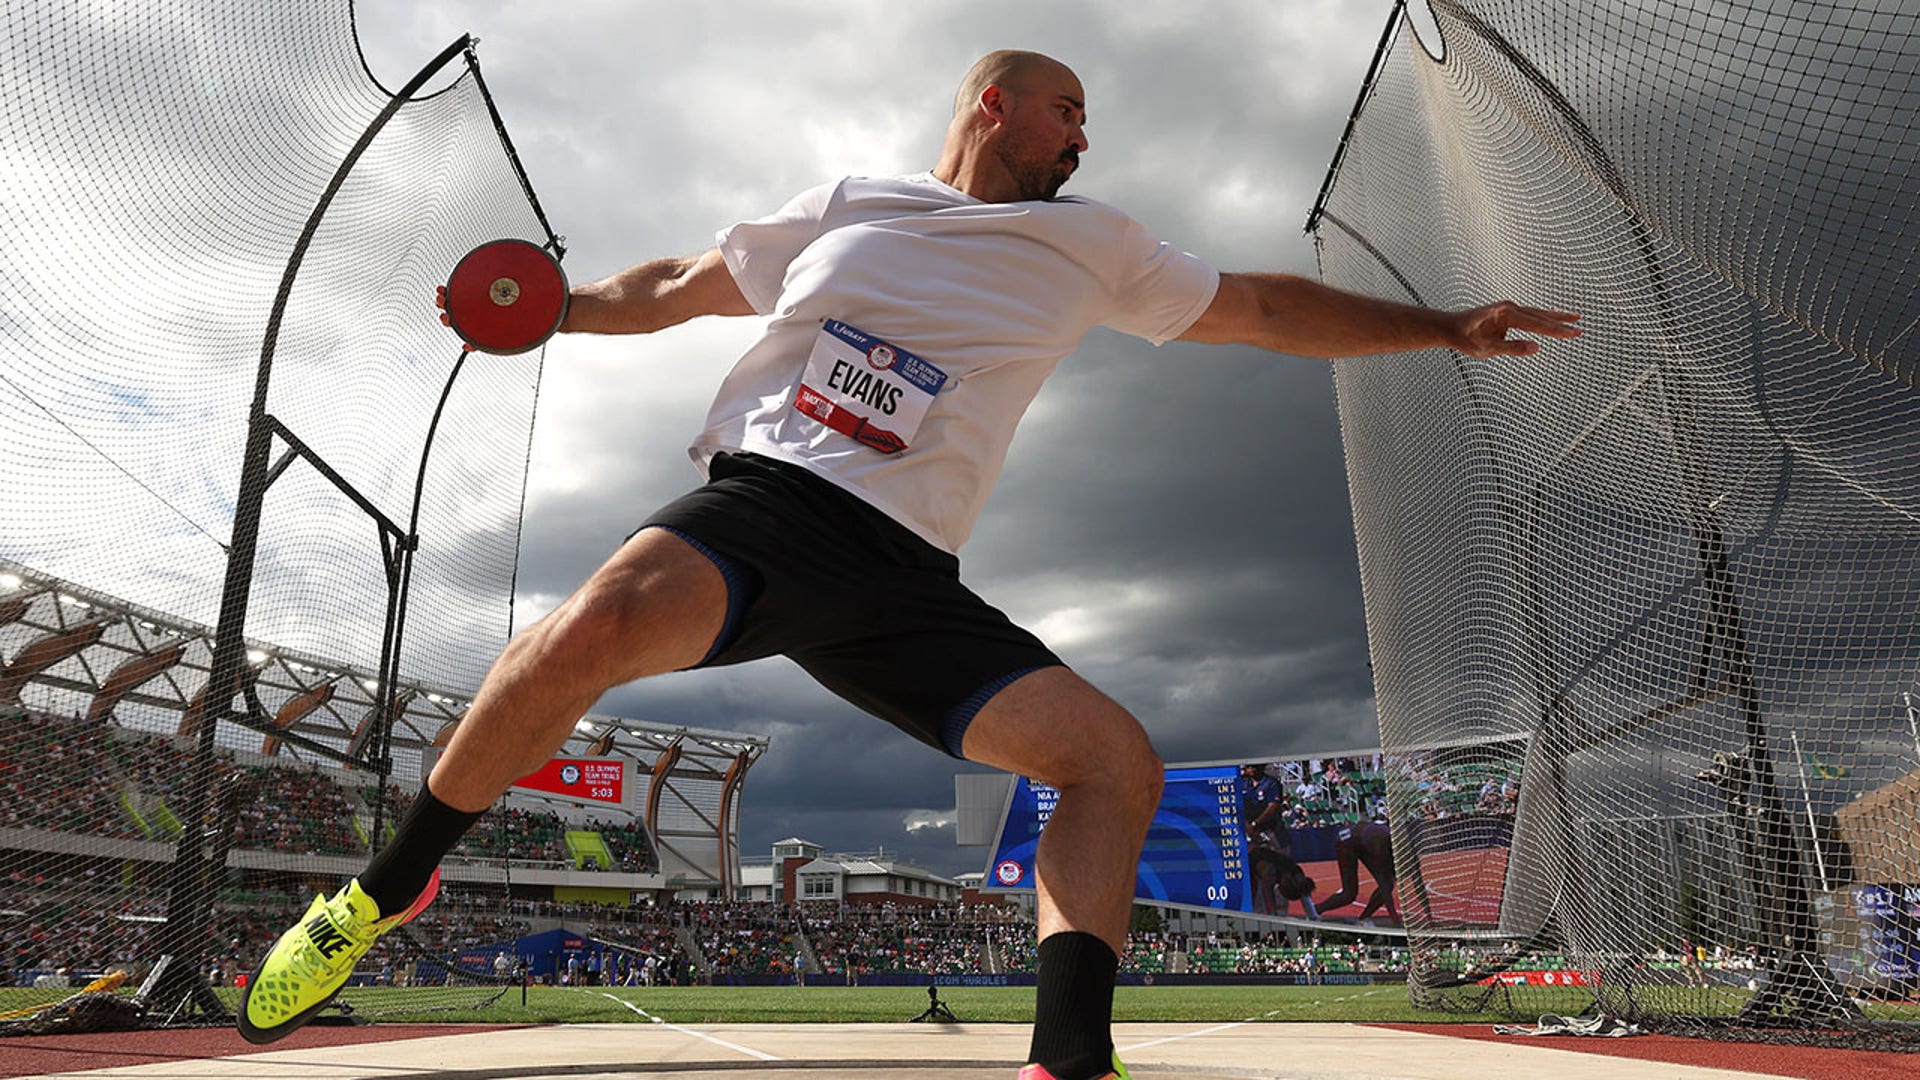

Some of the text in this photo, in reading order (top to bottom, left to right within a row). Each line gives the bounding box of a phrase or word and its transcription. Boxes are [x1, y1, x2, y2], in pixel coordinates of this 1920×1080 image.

[827, 359, 903, 415] EVANS
[592, 788, 613, 798] 5:03
[1217, 784, 1235, 793] LN 1
[1218, 794, 1236, 804] LN 2
[1219, 806, 1231, 815] LN
[1220, 816, 1239, 826] LN 4
[1221, 828, 1232, 836] LN
[1222, 838, 1240, 847] LN 6
[1223, 848, 1240, 858] LN 7
[1224, 860, 1235, 869] LN
[1224, 870, 1243, 880] LN 9
[1207, 886, 1228, 900] 0.0
[304, 913, 353, 959] NIKE
